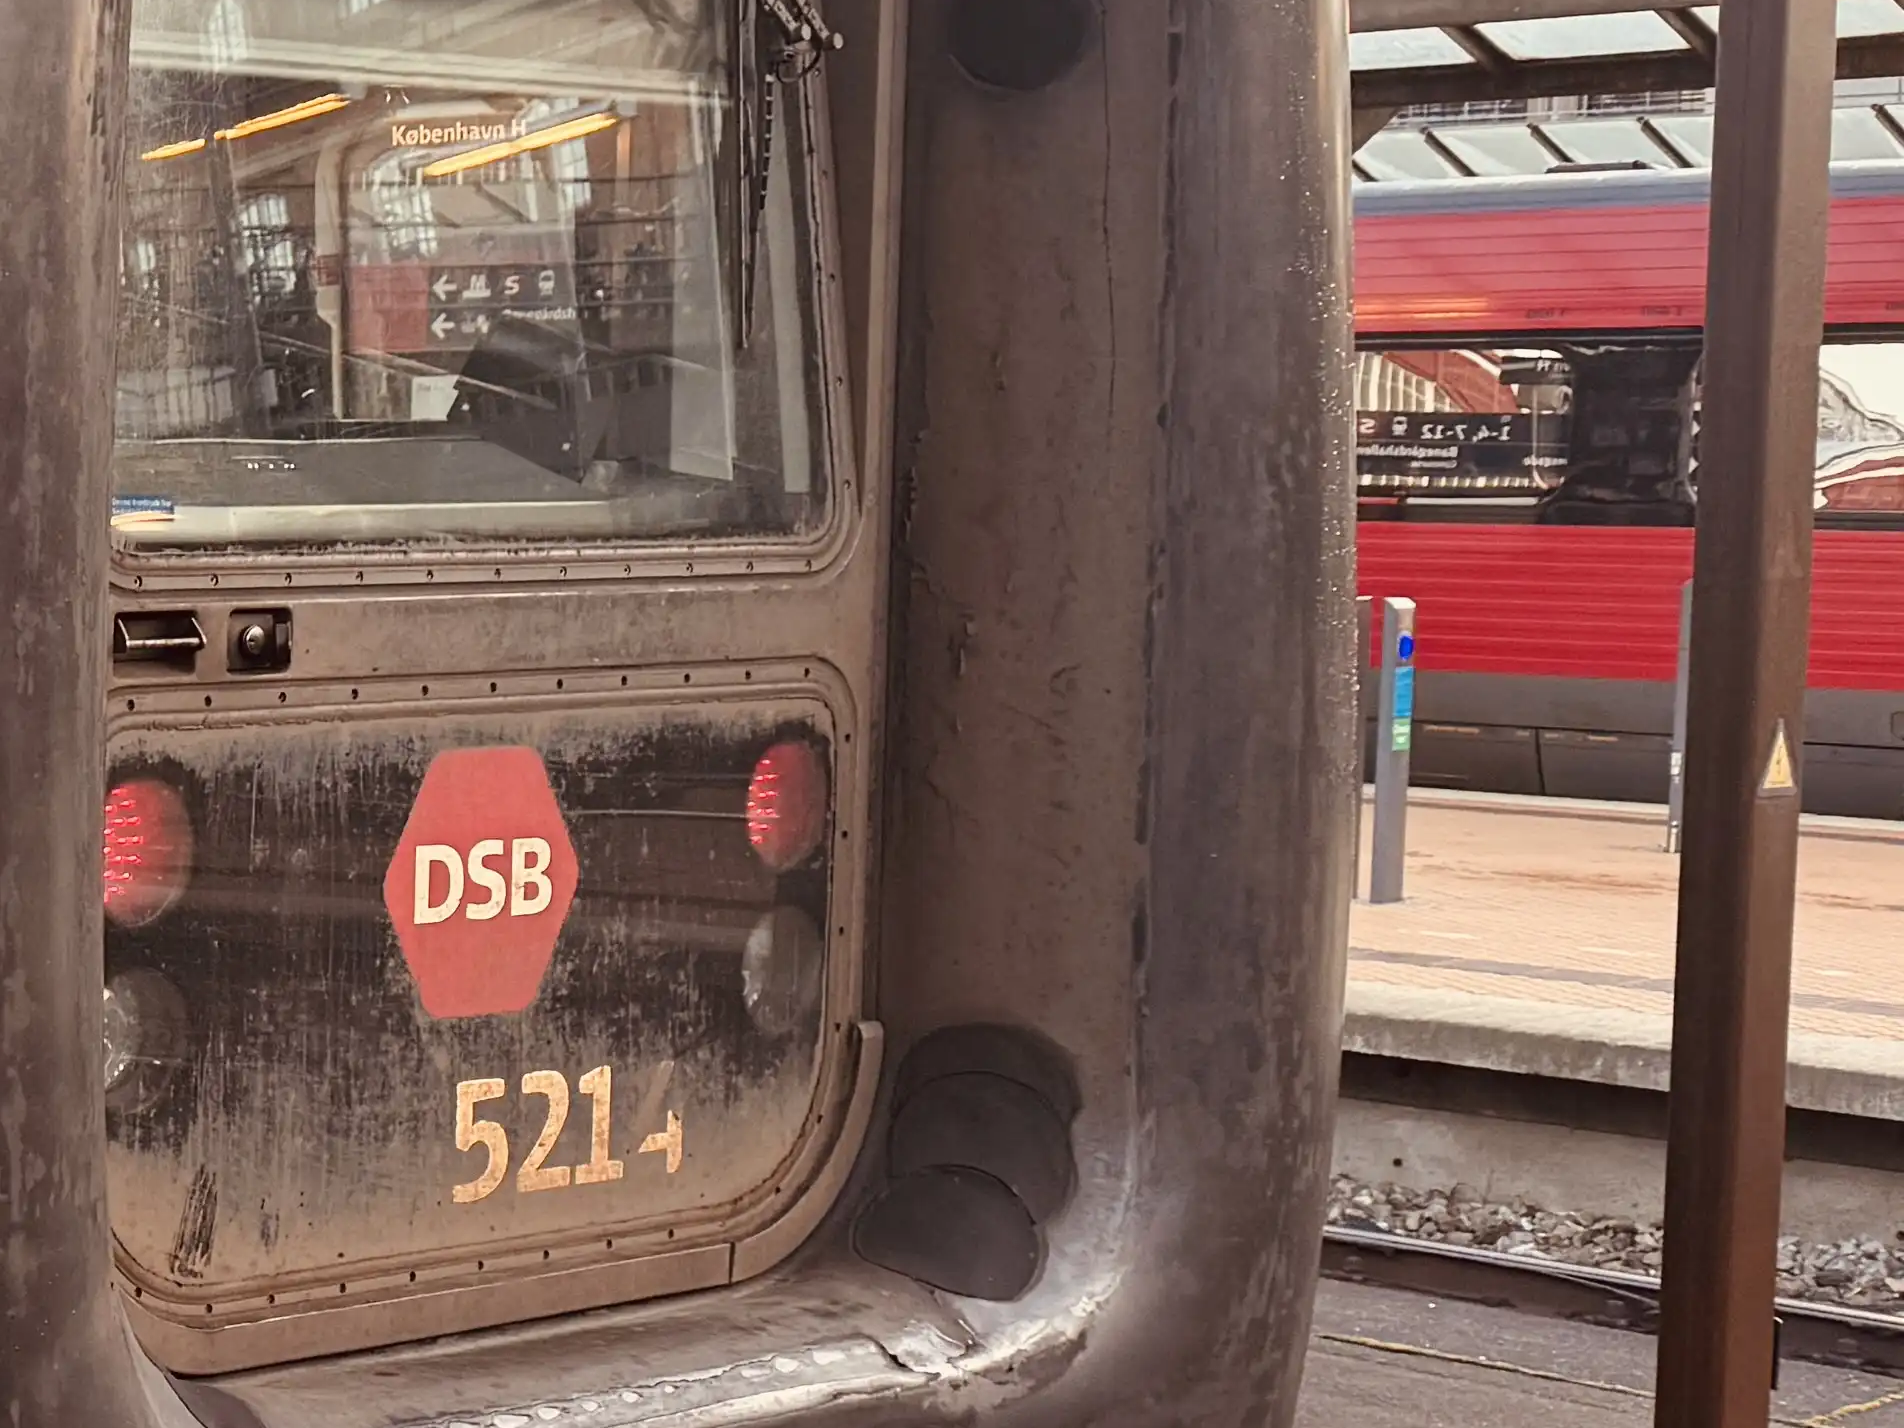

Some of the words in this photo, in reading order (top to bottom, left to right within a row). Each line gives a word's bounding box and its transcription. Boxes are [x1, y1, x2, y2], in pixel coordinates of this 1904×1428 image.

[392, 121, 505, 147] København
[511, 119, 526, 137] H
[413, 837, 553, 925] DSB
